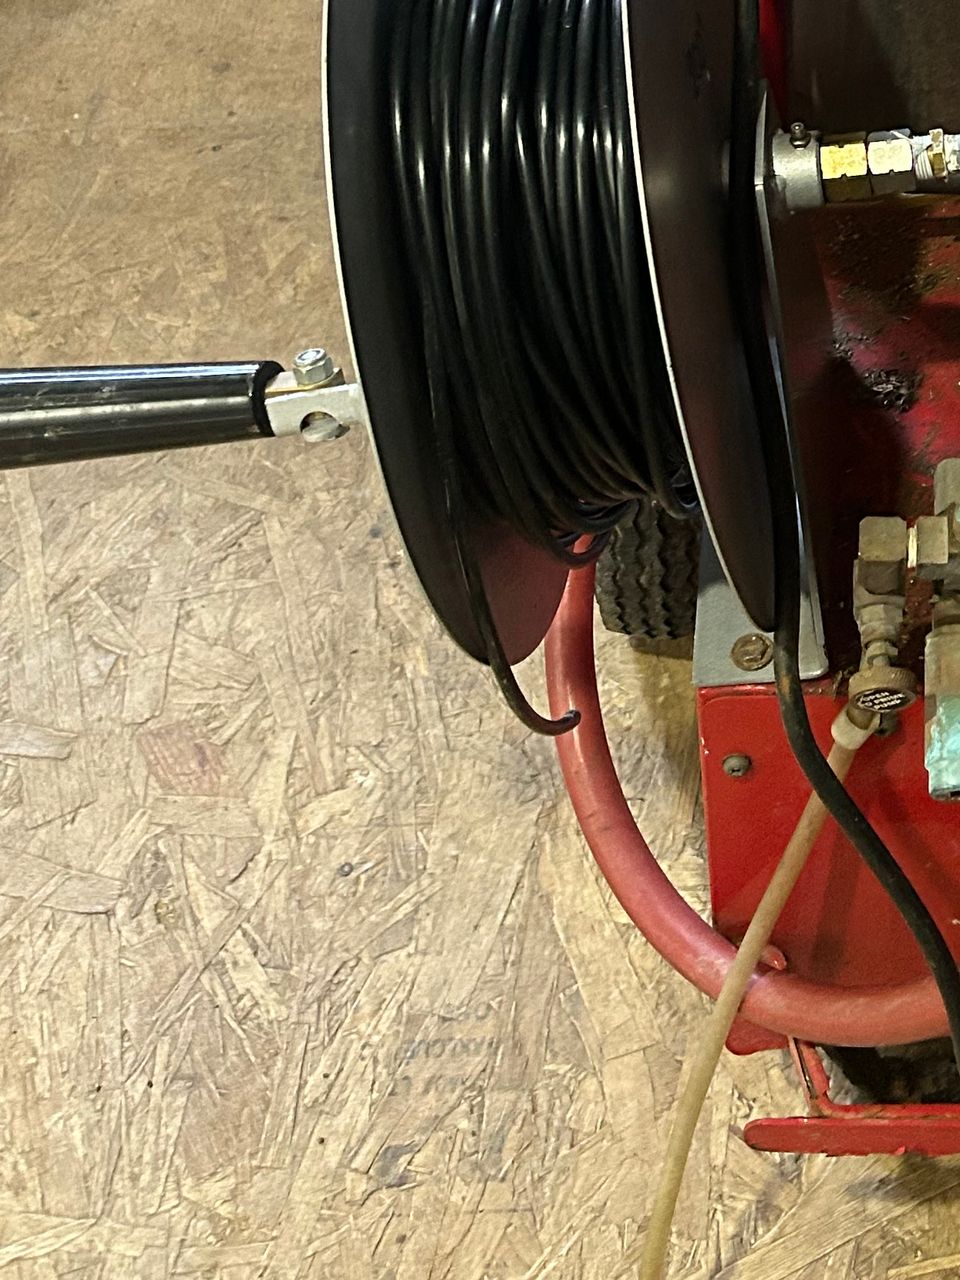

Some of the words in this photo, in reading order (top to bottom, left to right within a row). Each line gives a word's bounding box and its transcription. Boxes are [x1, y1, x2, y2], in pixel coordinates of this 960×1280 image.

[863, 691, 890, 701] OPEN
[873, 693, 905, 704] PRIME
[873, 699, 901, 710] PUMP
